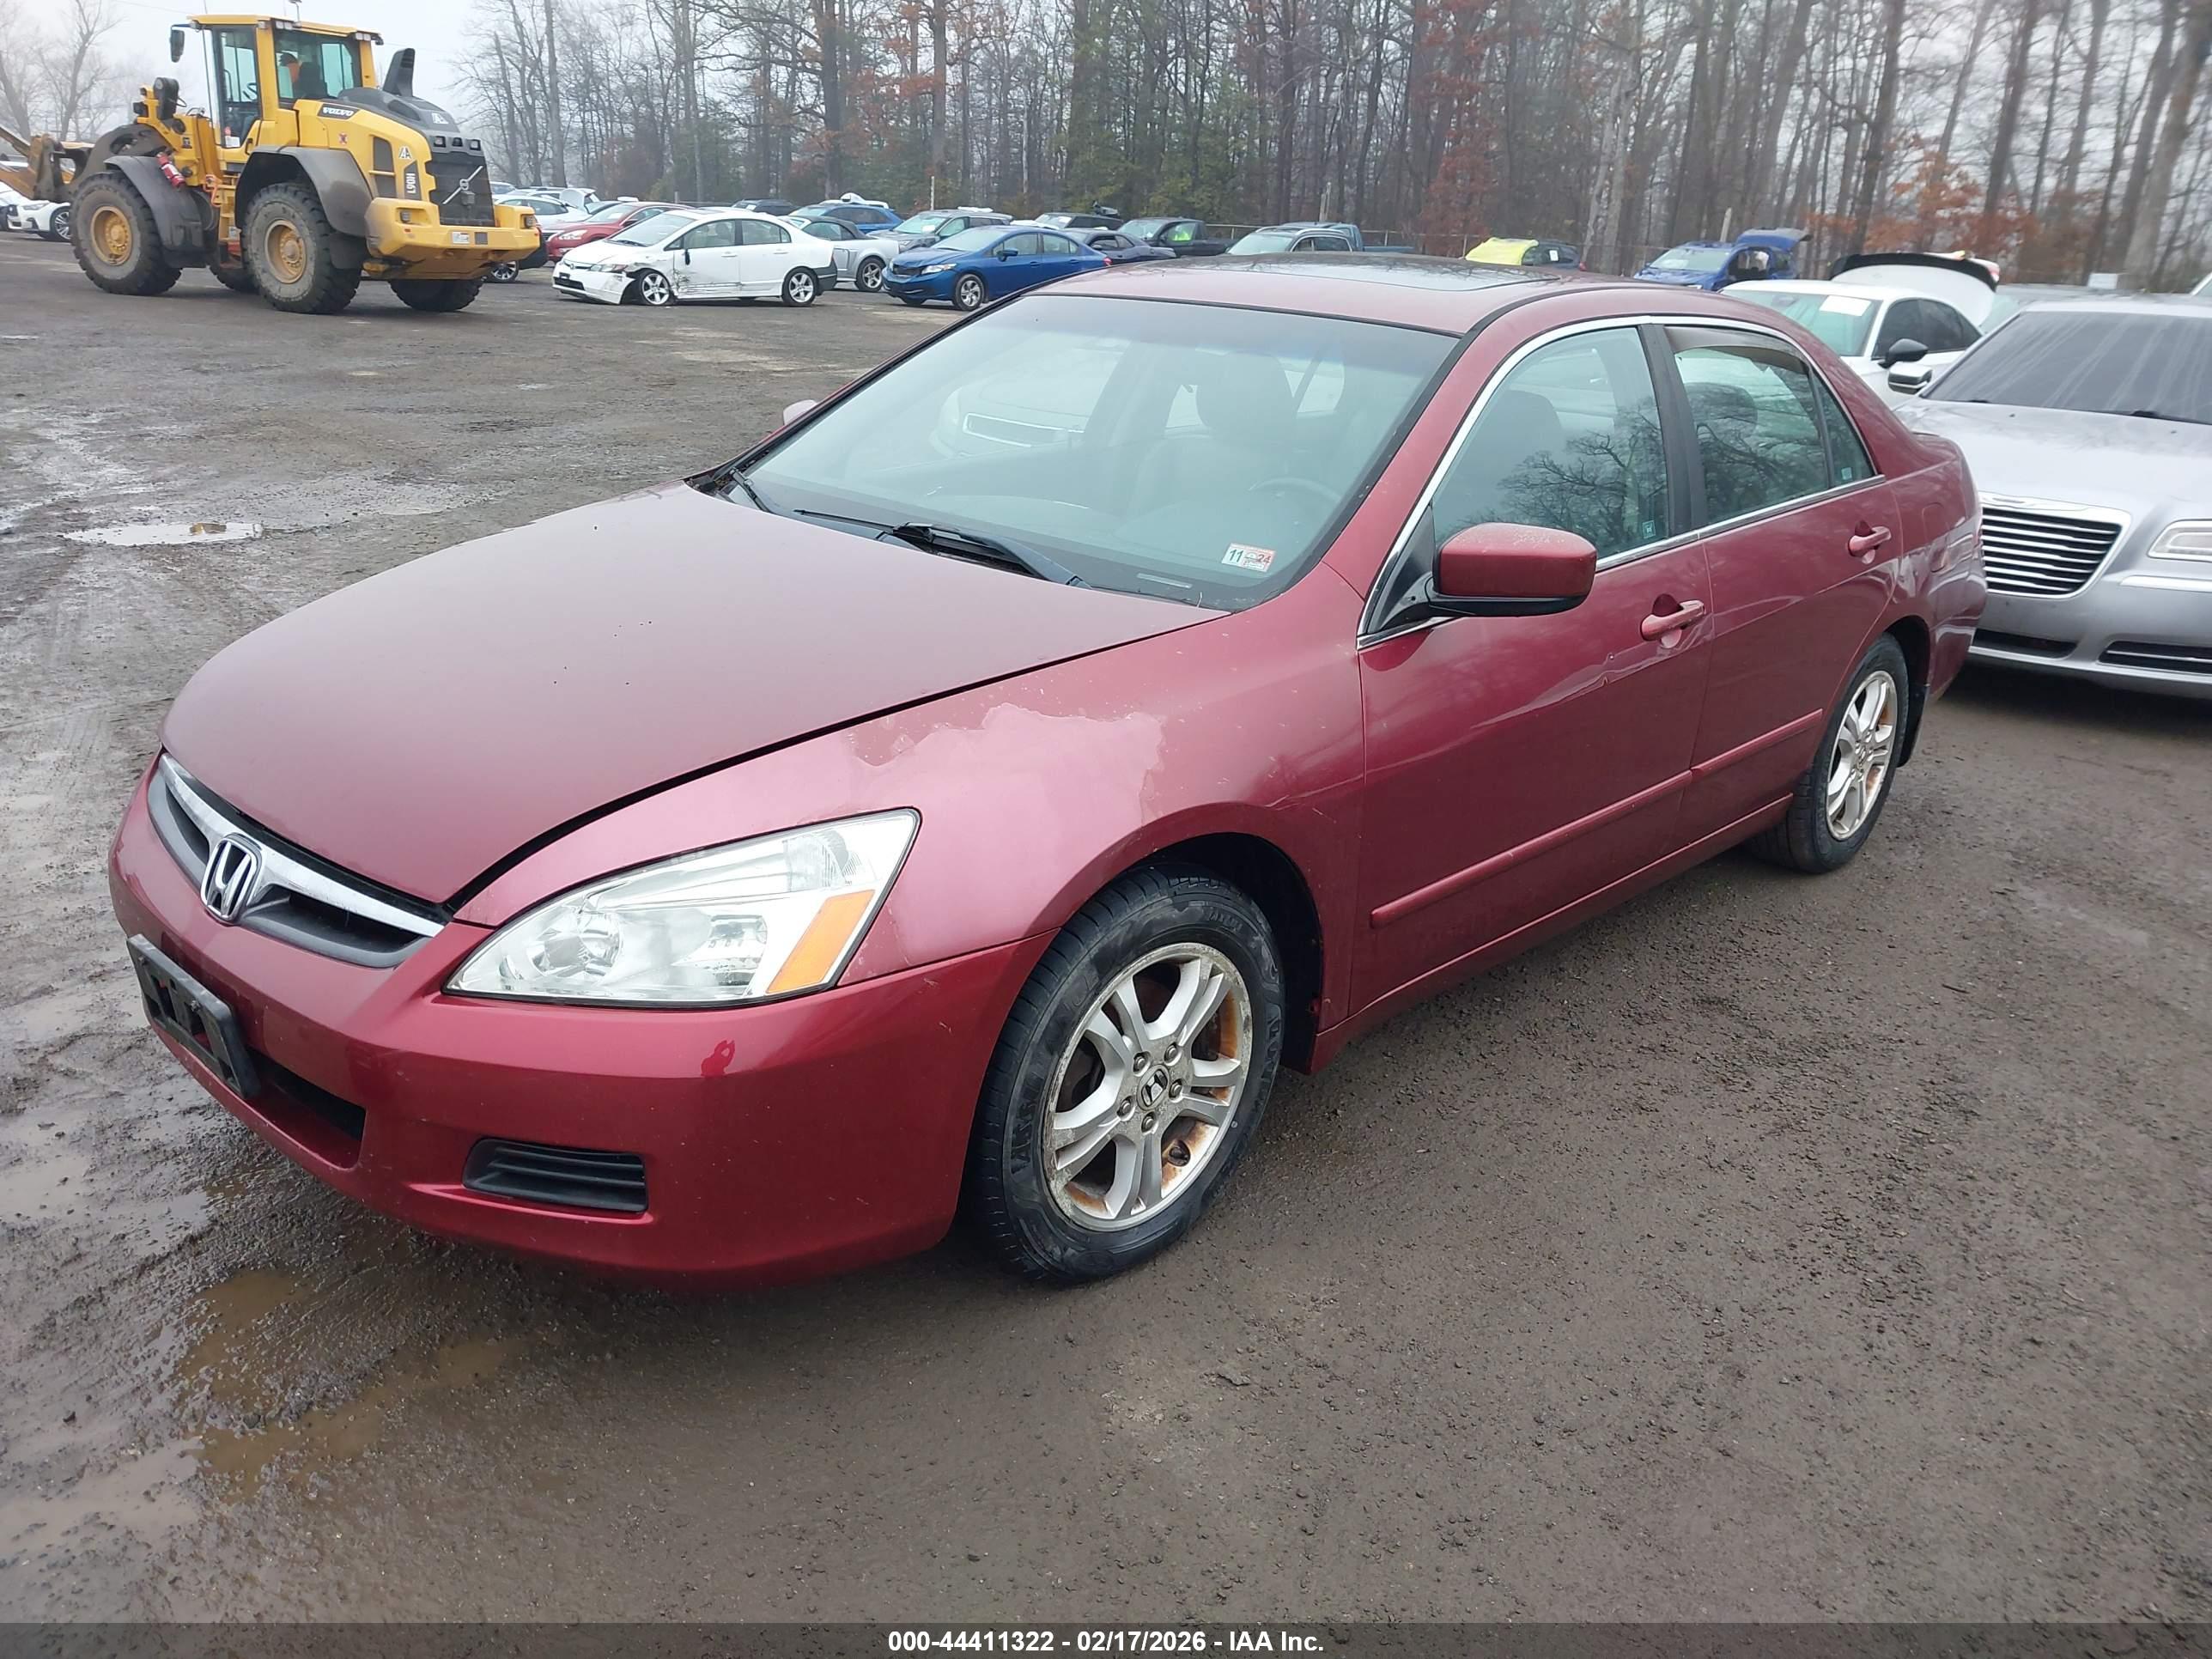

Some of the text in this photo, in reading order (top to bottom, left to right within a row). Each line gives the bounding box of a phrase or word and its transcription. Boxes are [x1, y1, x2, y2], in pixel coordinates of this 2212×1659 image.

[323, 106, 354, 117] VOLVO
[406, 173, 416, 193] L90H
[1230, 550, 1243, 562] 11
